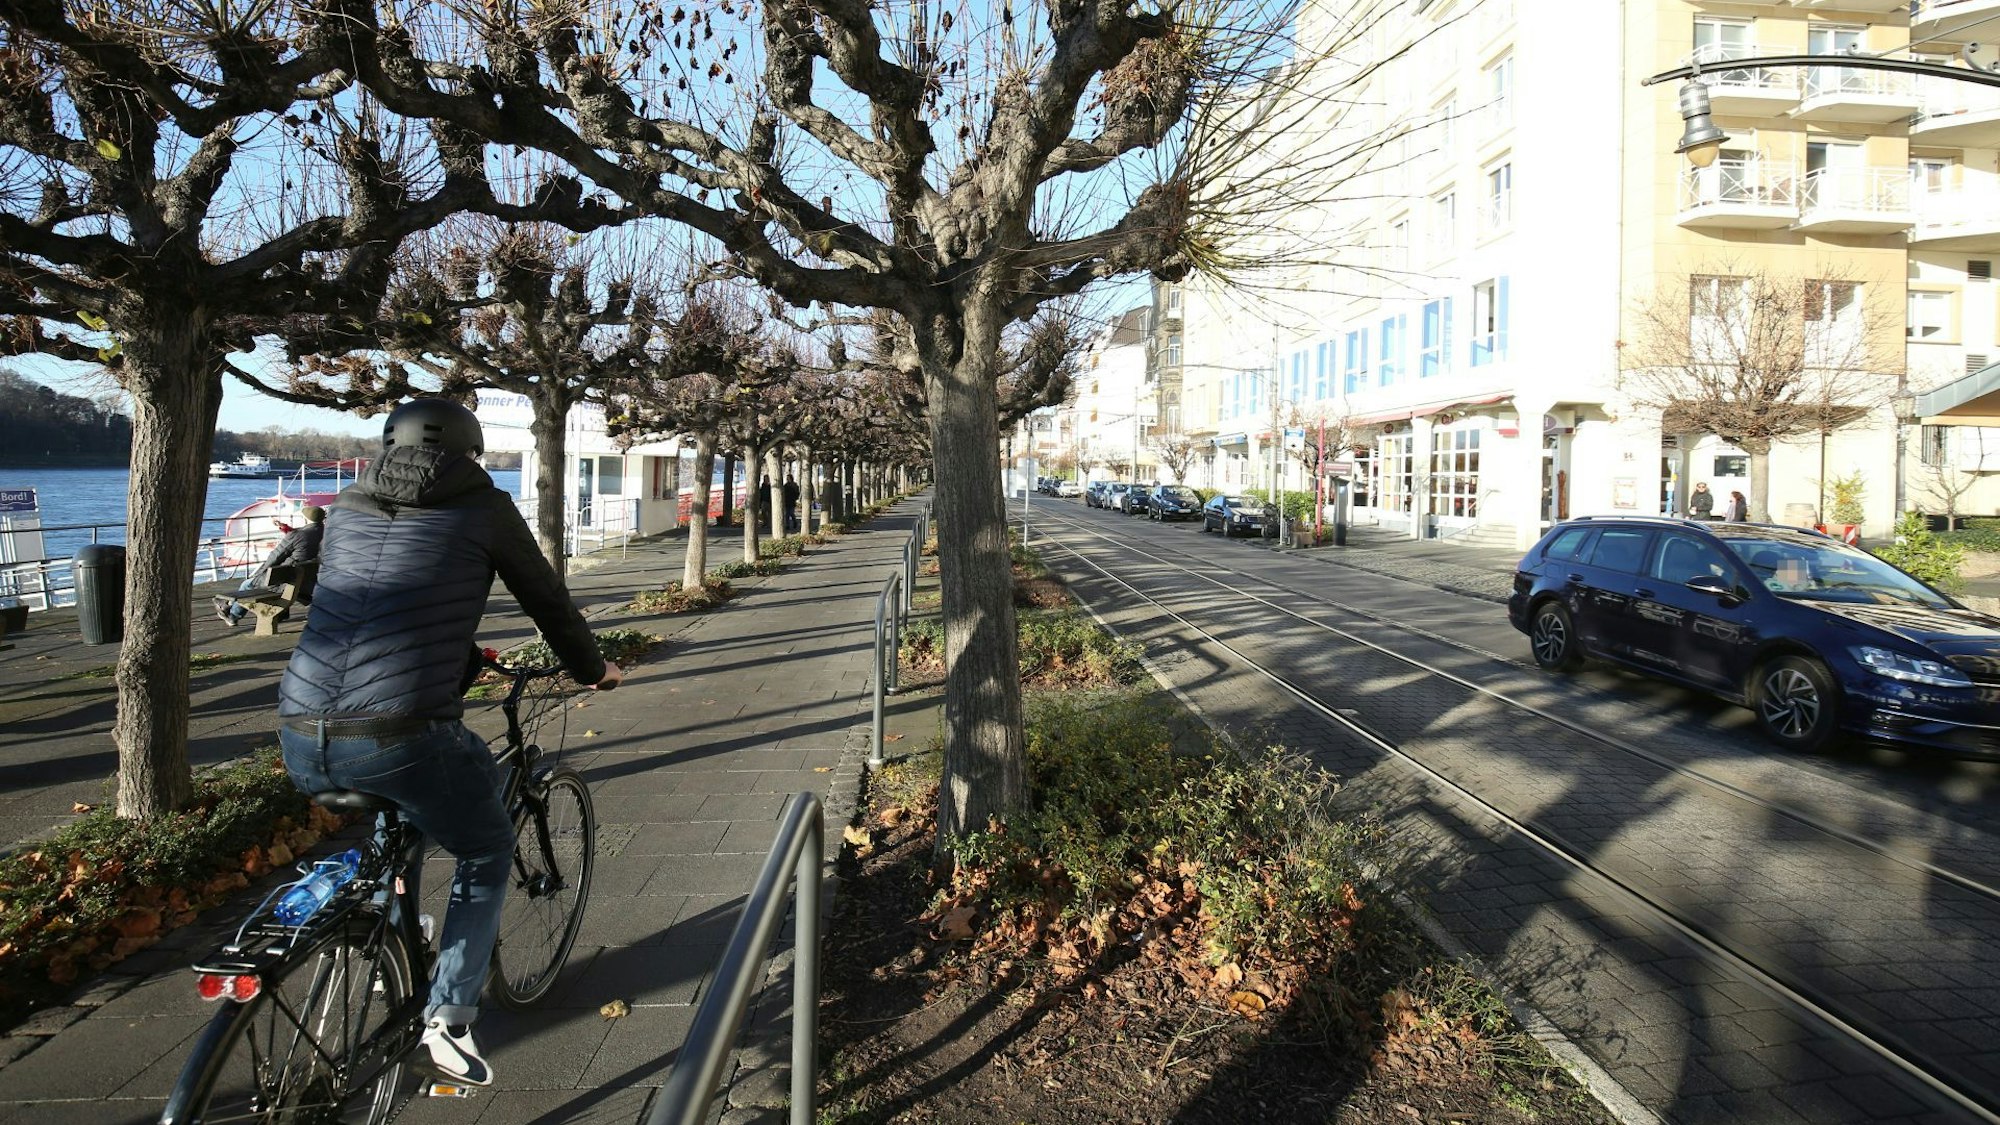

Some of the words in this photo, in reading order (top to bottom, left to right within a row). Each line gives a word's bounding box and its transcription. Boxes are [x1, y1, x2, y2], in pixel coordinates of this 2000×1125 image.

[477, 396, 514, 406] onner
[516, 395, 532, 407] Pe
[1, 492, 27, 501] Bord!
